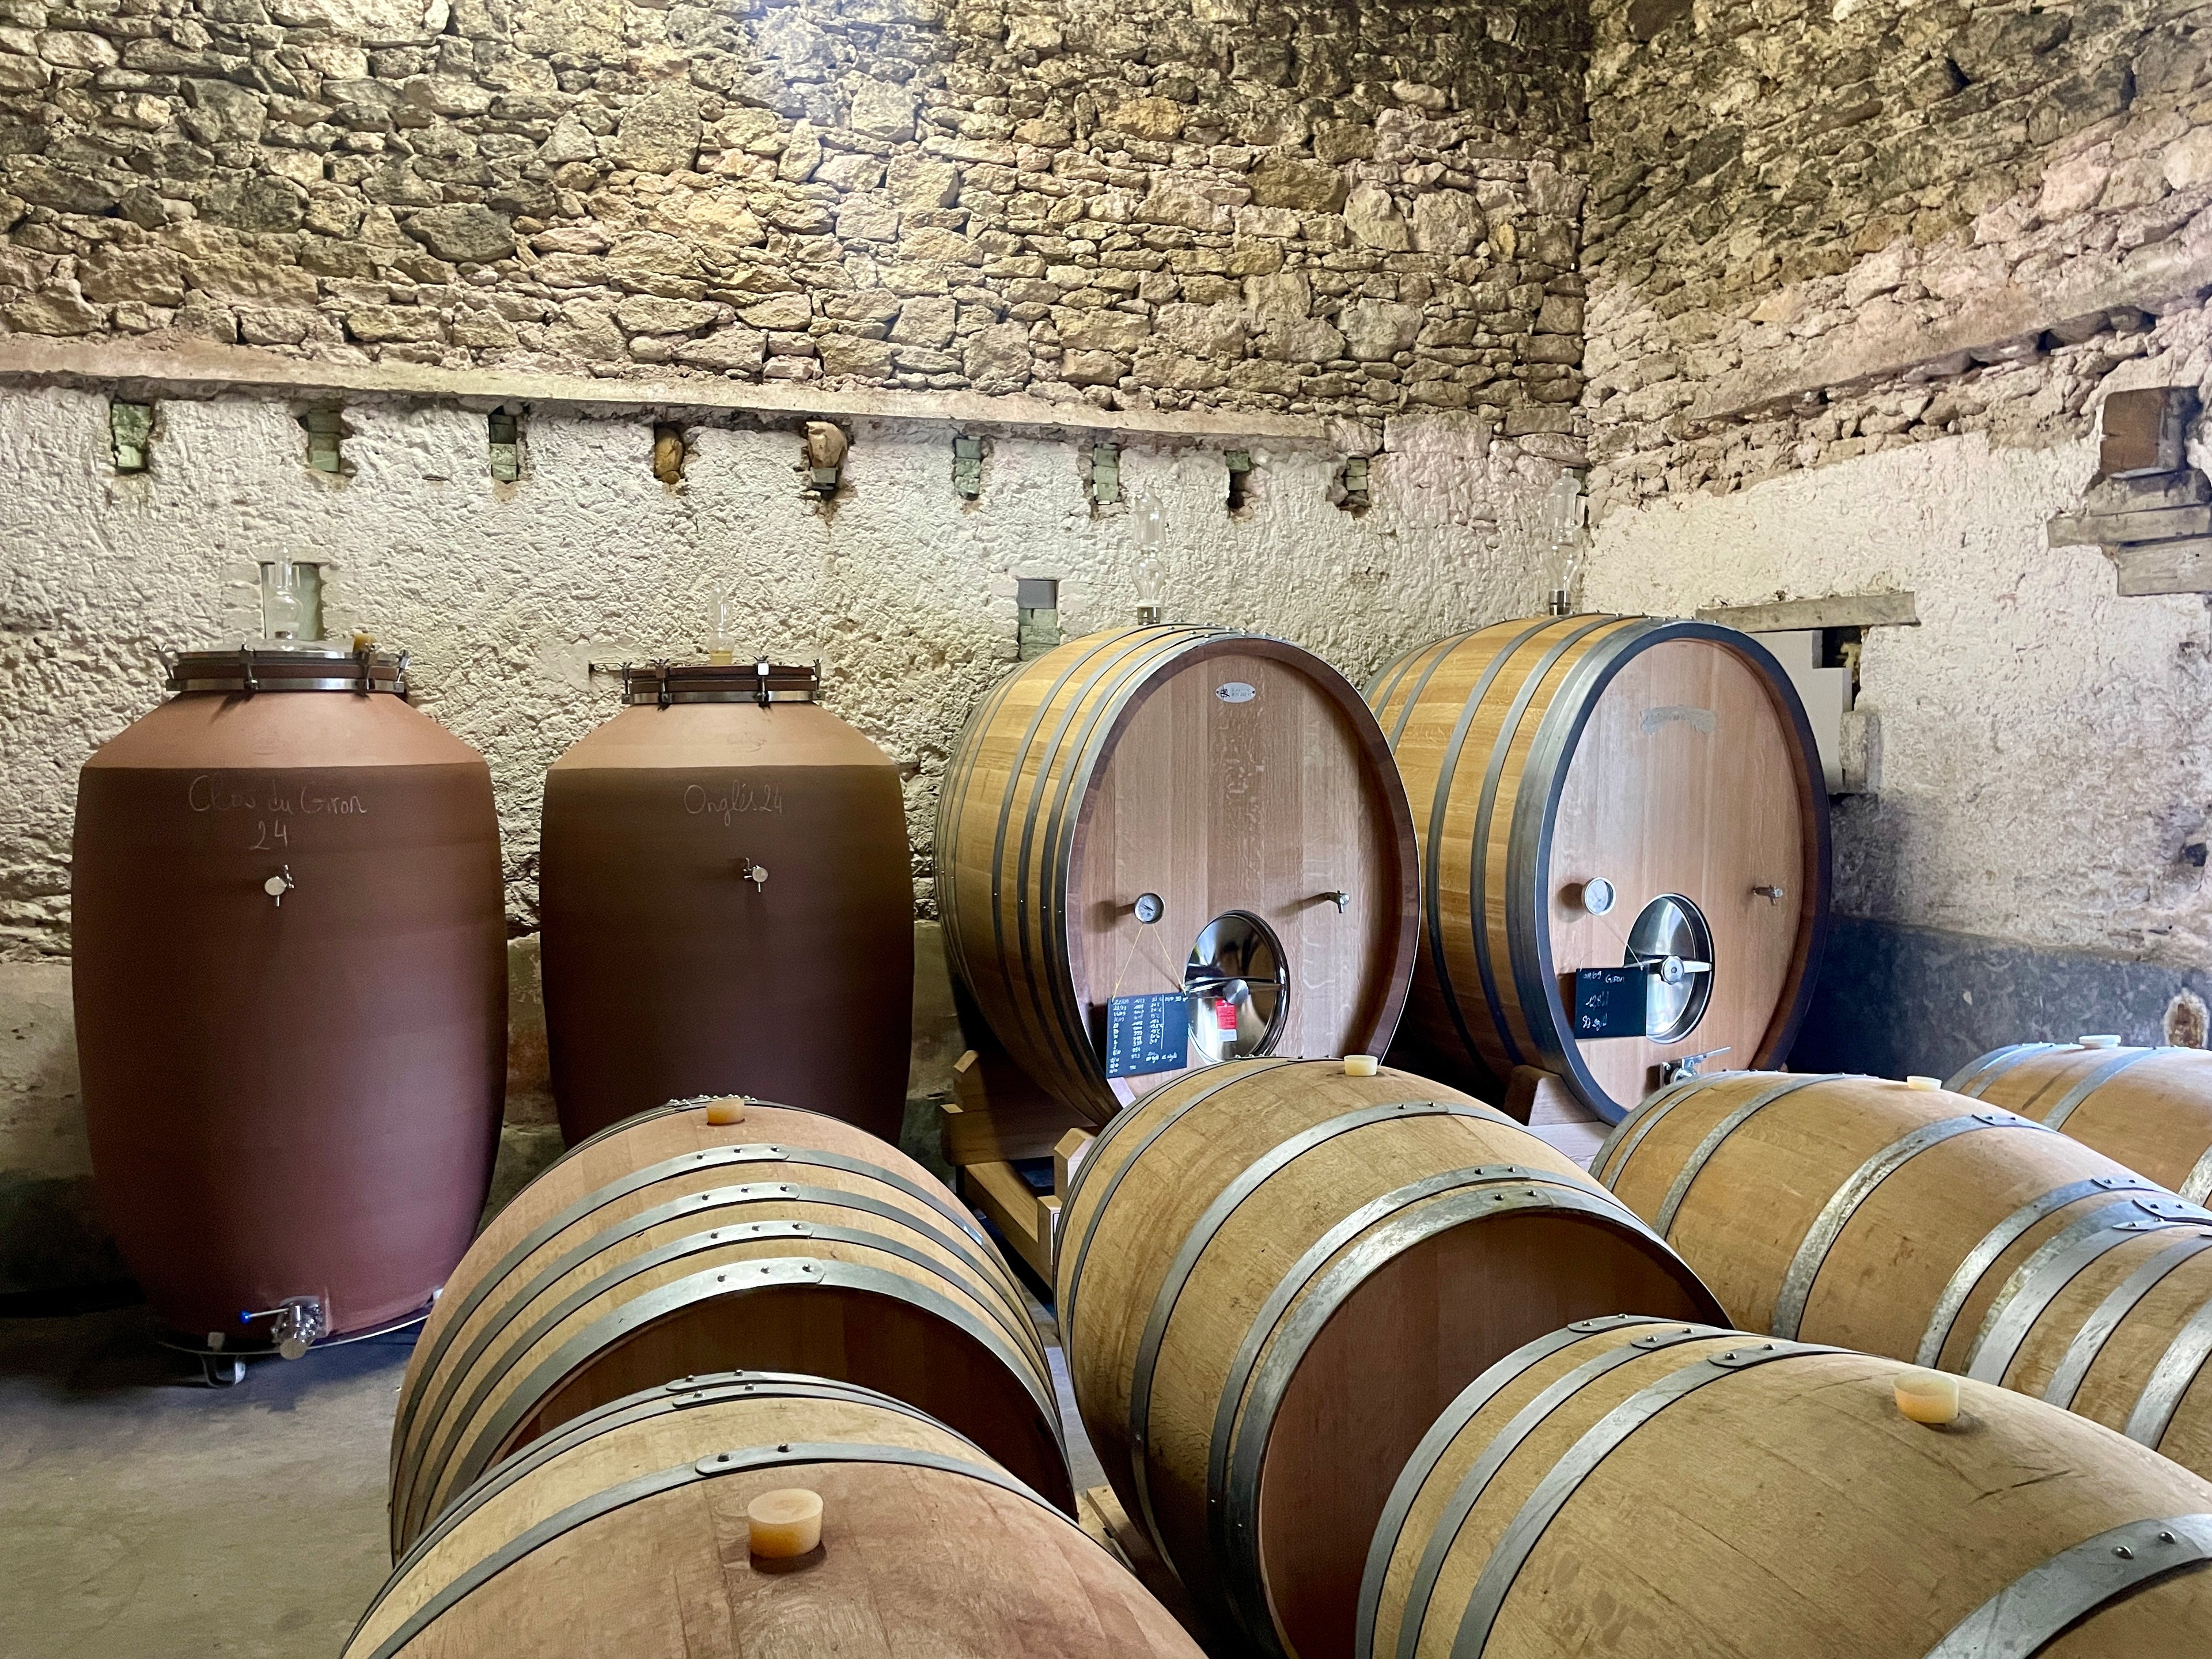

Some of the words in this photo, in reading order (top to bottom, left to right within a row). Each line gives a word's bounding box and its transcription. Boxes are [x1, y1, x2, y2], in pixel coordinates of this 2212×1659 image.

[268, 779, 294, 815] du
[759, 784, 783, 815] 24
[248, 819, 288, 850] 24
